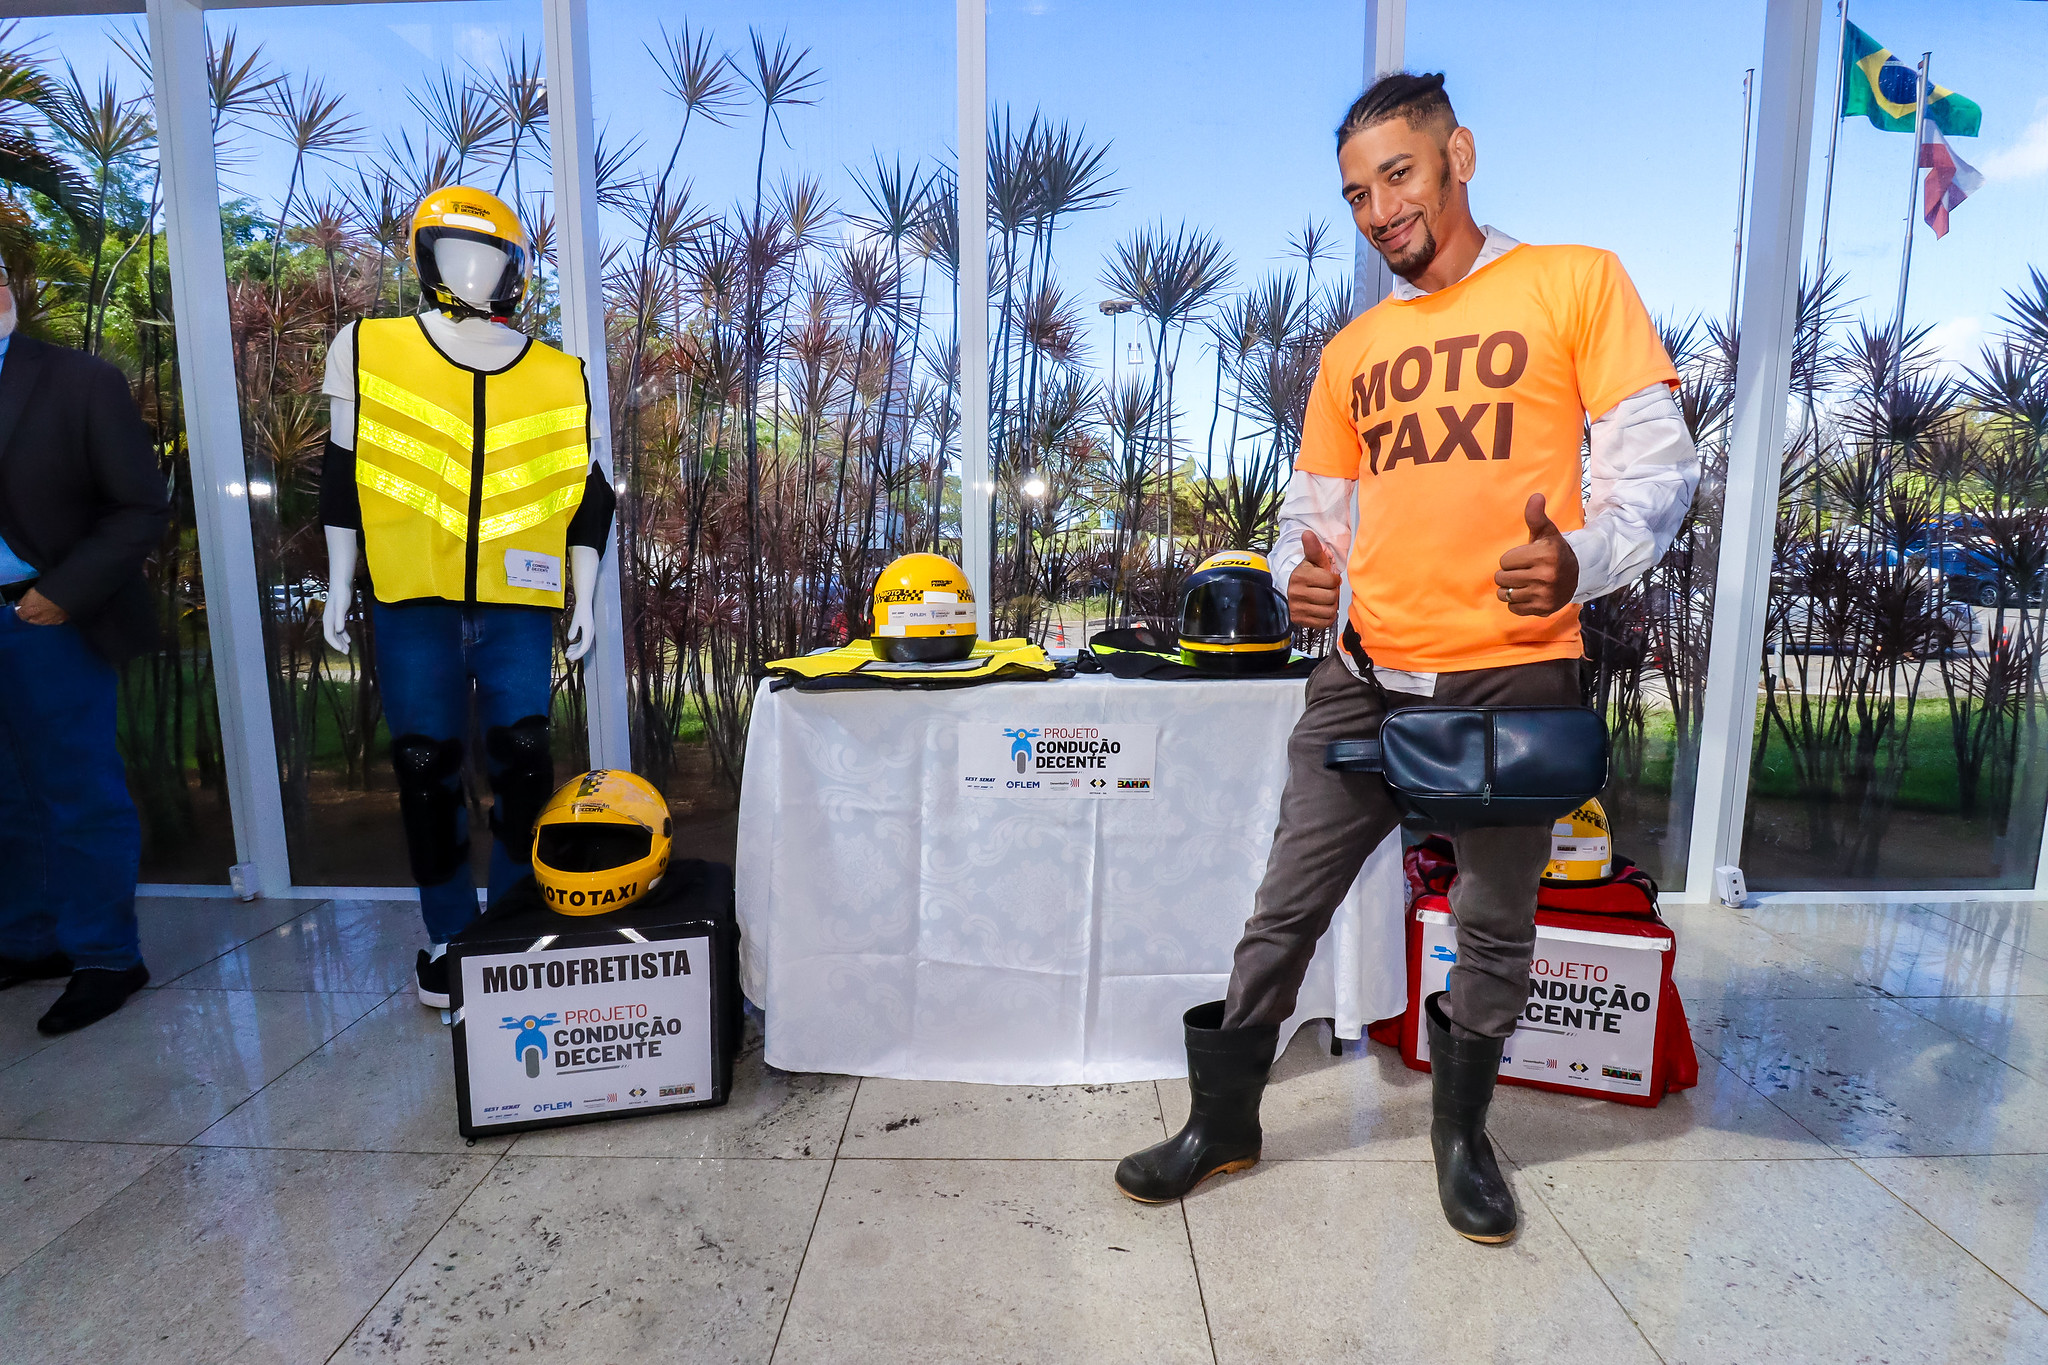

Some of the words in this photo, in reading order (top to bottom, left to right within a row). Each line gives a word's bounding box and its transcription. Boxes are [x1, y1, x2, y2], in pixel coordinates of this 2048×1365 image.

[1351, 330, 1529, 422] MOTO
[1361, 402, 1514, 476] TAXI
[1044, 728, 1099, 739] PROJETO
[1036, 738, 1121, 756] CONDUÇÃO
[1036, 756, 1107, 769] DECENTE
[1117, 780, 1150, 789] BAHIA
[482, 950, 691, 994] MOTOFRETISTA
[1529, 979, 1651, 1012] NDUÇÃO
[565, 1004, 648, 1025] PROJETO
[1518, 1002, 1622, 1034] CENTE
[554, 1016, 682, 1047] CONDUÇÃO
[555, 1041, 662, 1068] DECENTE
[1602, 1067, 1643, 1081] BAHIA
[659, 1085, 696, 1097] BAHIA
[543, 1101, 573, 1111] FLEM
